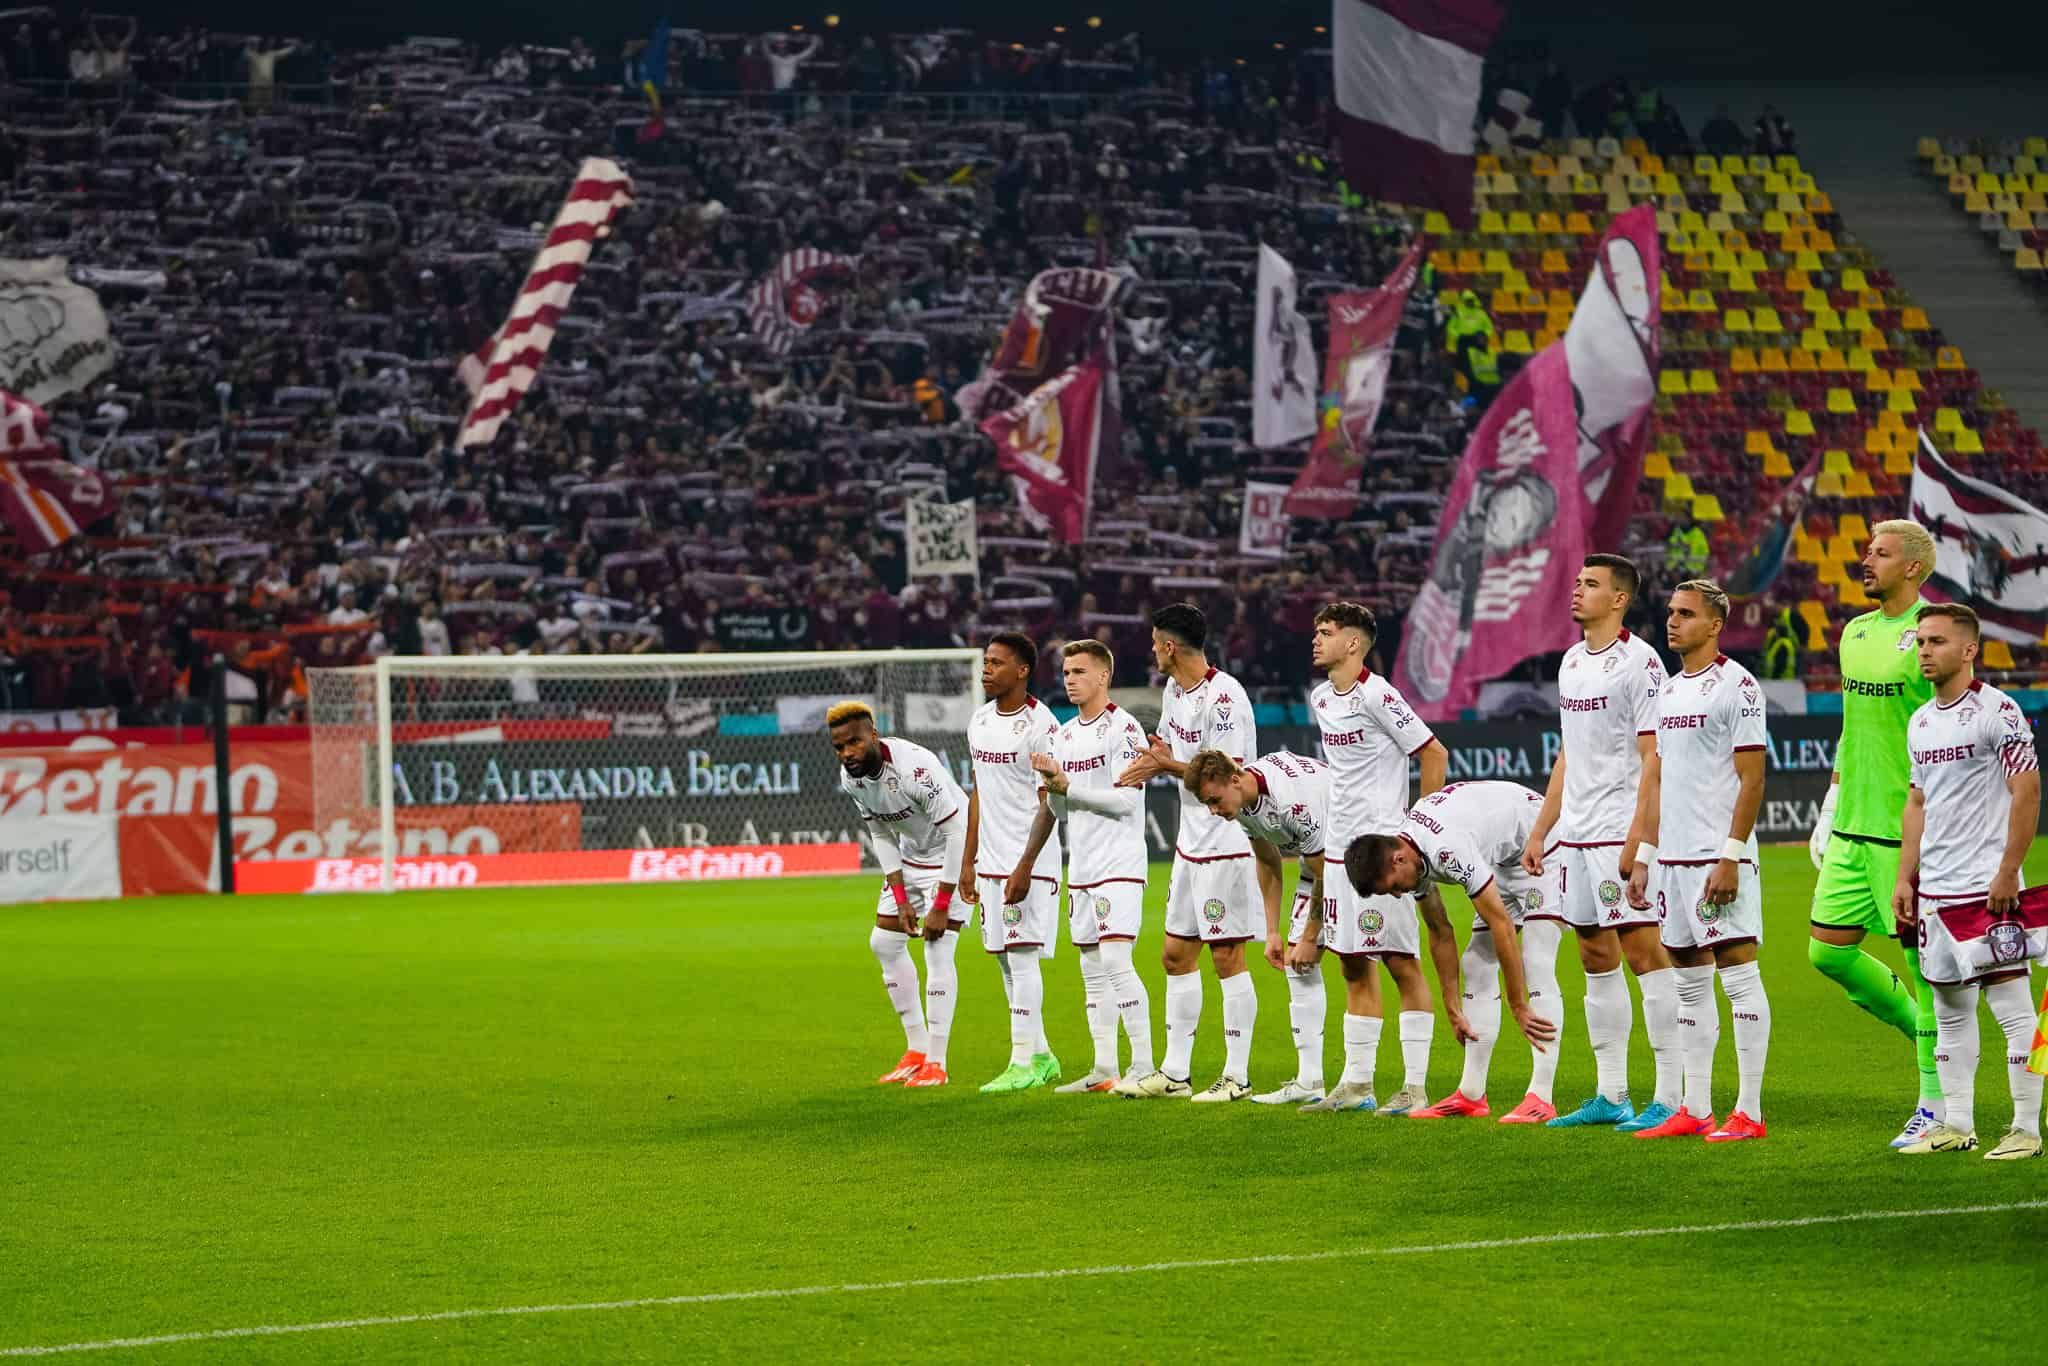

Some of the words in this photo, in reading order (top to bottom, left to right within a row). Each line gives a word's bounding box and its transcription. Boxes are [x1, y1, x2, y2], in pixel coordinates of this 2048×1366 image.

[1217, 723, 1234, 732] DSC
[1742, 707, 1760, 717] DSC
[1764, 729, 1837, 771] ALEX
[1913, 744, 1976, 765] SUPERBET
[0, 756, 278, 817] Betano
[431, 761, 460, 803] B
[629, 850, 785, 881] Betano
